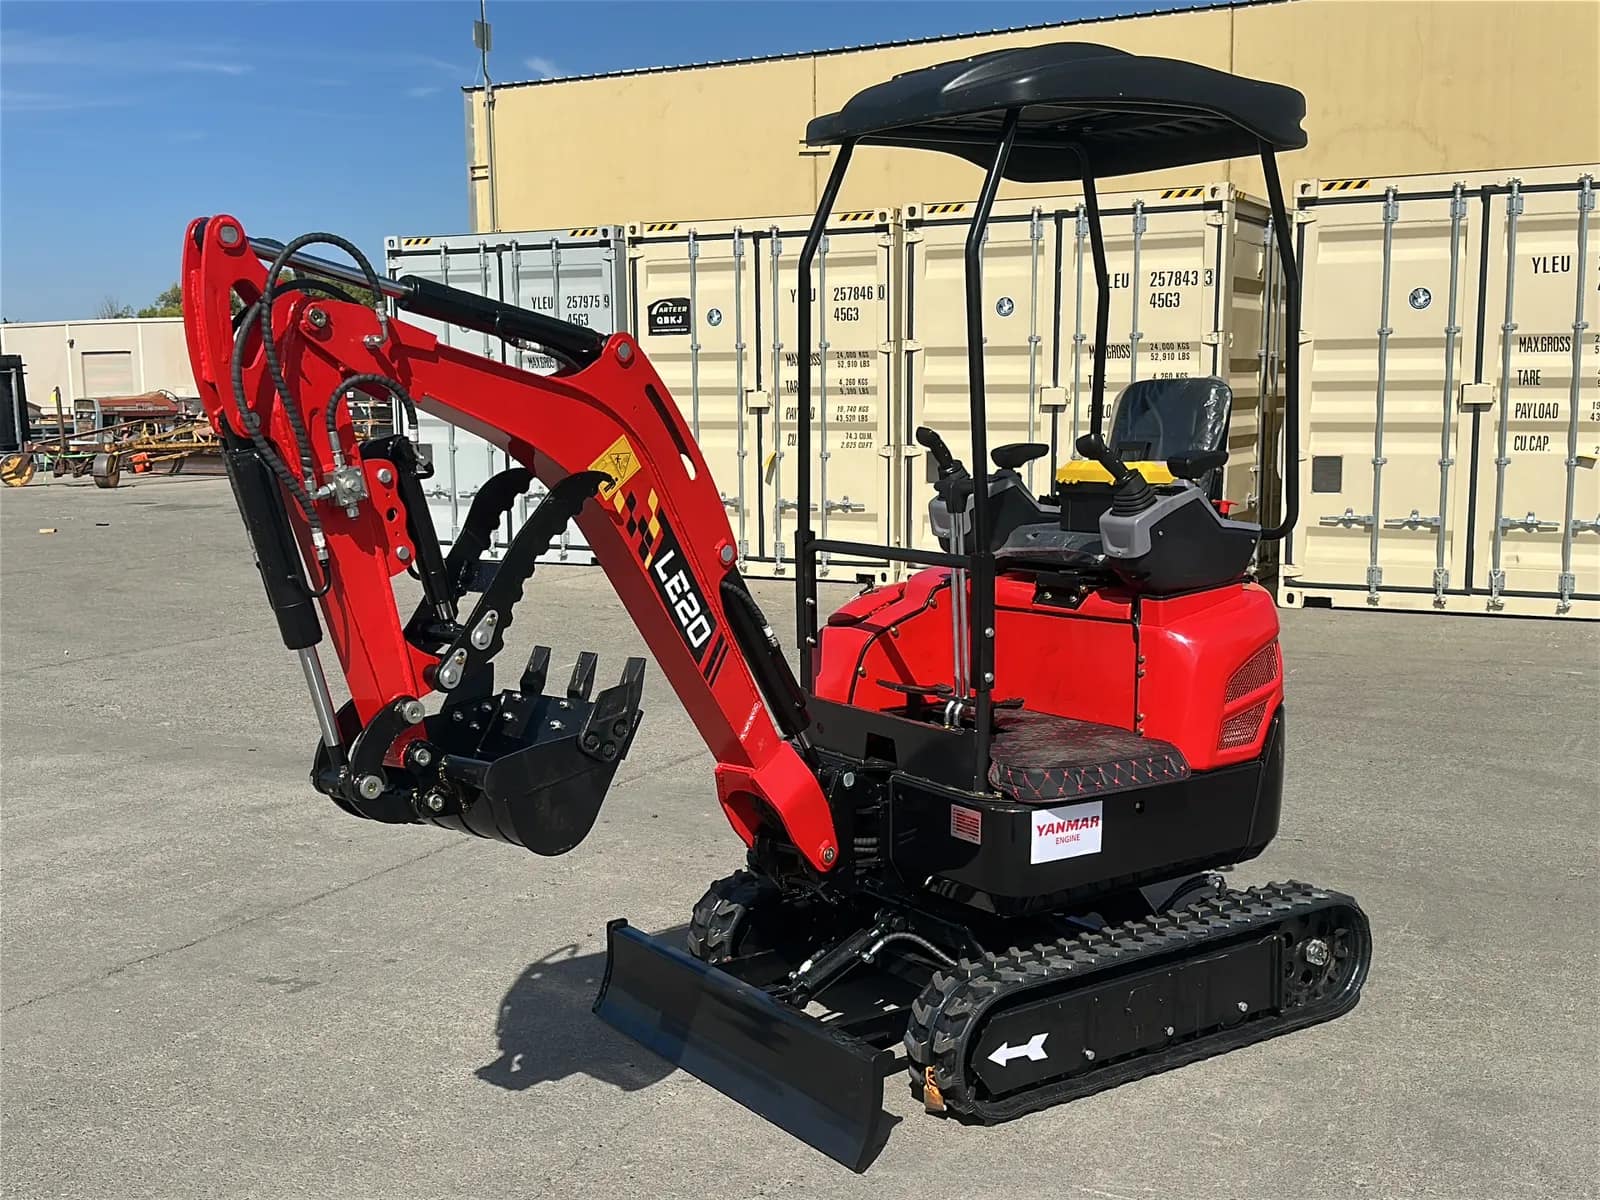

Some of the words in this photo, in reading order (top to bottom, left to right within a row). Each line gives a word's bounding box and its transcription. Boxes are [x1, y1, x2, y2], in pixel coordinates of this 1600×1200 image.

[1531, 255, 1570, 274] YLEU
[1107, 272, 1130, 288] LEU
[1149, 270, 1199, 288] 257843
[1204, 269, 1213, 286] 3
[790, 288, 816, 303] YU
[833, 286, 873, 302] 257846
[878, 284, 885, 300] 0
[1149, 292, 1181, 309] 45G3
[531, 296, 554, 310] YLEU
[566, 295, 600, 309] 257975
[604, 294, 610, 309] 9
[656, 316, 683, 325] QBKJ
[834, 307, 859, 321] 45G3
[1149, 343, 1175, 352] 24,000
[1177, 342, 1190, 351] KGS
[837, 360, 858, 368] 52,910
[859, 360, 870, 368] LBS
[1150, 352, 1175, 361] 52,910
[1177, 352, 1191, 361] LBS
[1517, 369, 1541, 386] TARE
[785, 379, 799, 393] TAR
[858, 414, 869, 422] LBS
[1514, 402, 1559, 419] PAYLOAD
[654, 549, 712, 649] LE20
[1036, 815, 1100, 837] YANMAR
[1055, 833, 1081, 845] ENGINE
